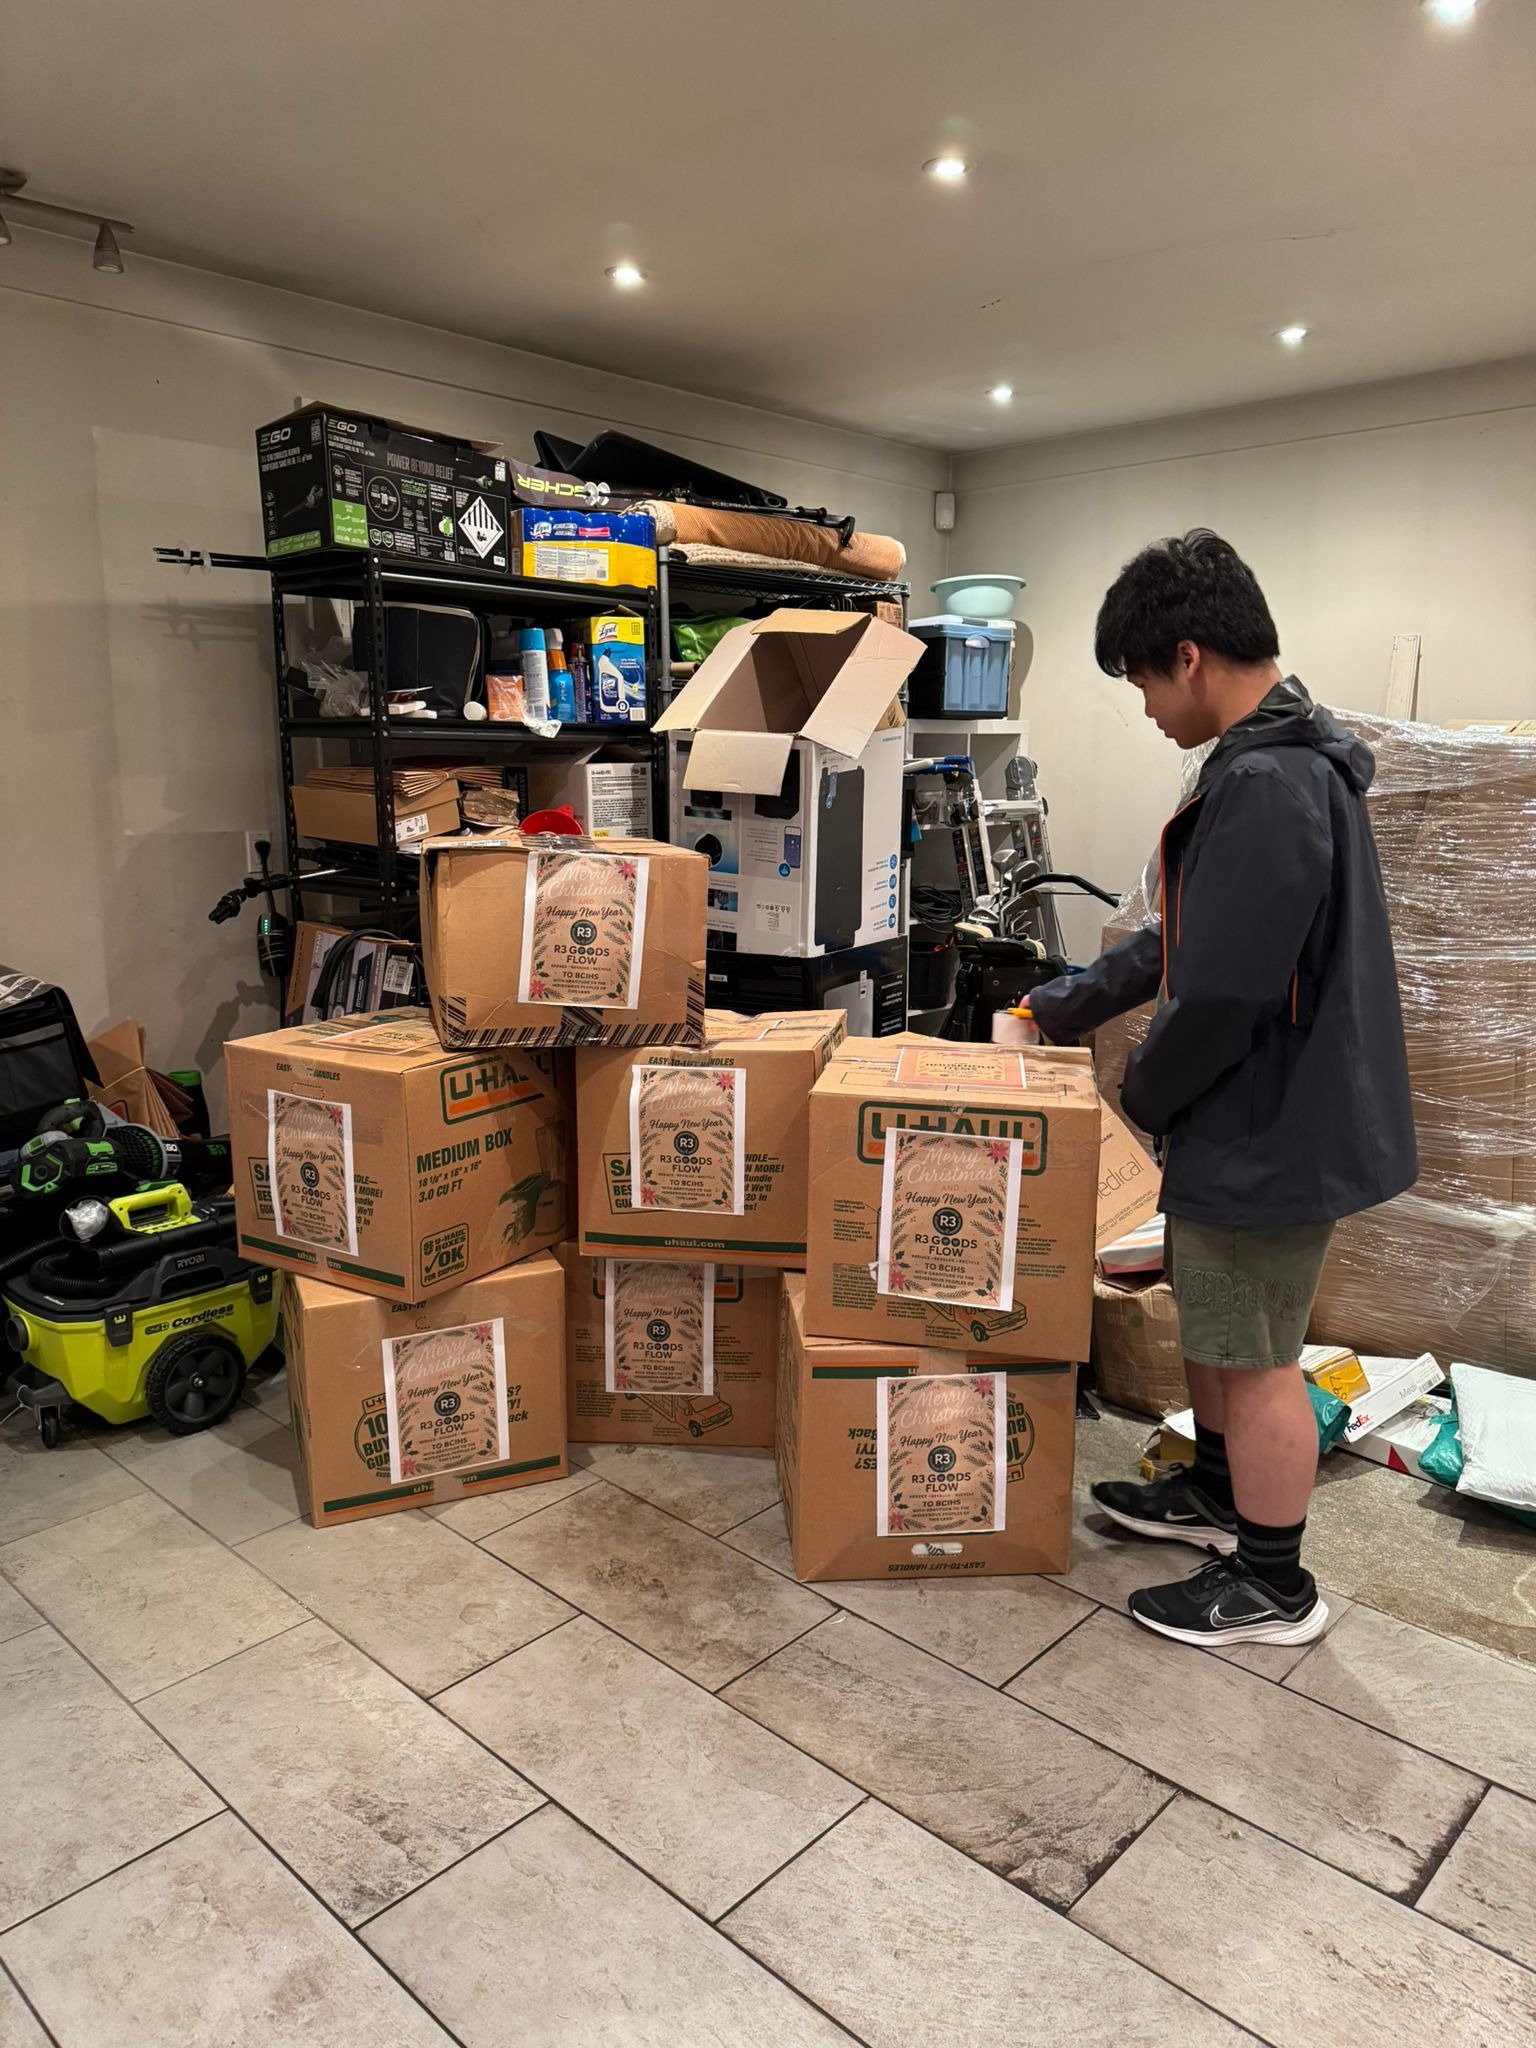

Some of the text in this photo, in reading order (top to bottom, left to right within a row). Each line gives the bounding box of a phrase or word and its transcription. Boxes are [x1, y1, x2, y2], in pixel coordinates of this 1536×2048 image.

[328, 418, 357, 433] EGO
[260, 427, 291, 446] EGO
[386, 452, 455, 480] POWER BEYOND BELIEF
[516, 473, 587, 498] SCHER
[533, 522, 552, 536] Lysol
[600, 624, 617, 636] Lysol
[519, 773, 527, 817] EARVIEW
[563, 866, 615, 886] Merry
[547, 880, 626, 900] Christmas
[546, 906, 624, 920] Happy New Year
[577, 926, 592, 938] R3
[554, 944, 610, 957] R3 GOODS
[566, 954, 598, 965] FLOW
[313, 1070, 340, 1081] HANDLES
[662, 1080, 712, 1096] Merry
[650, 1096, 725, 1113] Christmas
[290, 1109, 326, 1125] Merry
[650, 1118, 723, 1132] Happy New Year
[281, 1126, 335, 1140] Christmas
[166, 1143, 178, 1152] GO
[680, 1138, 694, 1148] R3
[282, 1146, 337, 1164] Happy New Year
[416, 1128, 513, 1174] MEDIUM BOX
[921, 1147, 982, 1167] Merry
[660, 1154, 712, 1166] R3 GOODS
[304, 1169, 316, 1180] R3
[672, 1164, 702, 1174] FLOW
[754, 1164, 785, 1173] MORE!
[906, 1163, 996, 1184] Christmas
[418, 1178, 428, 1188] 18
[752, 1184, 772, 1192] We'll
[940, 1184, 960, 1192] AND
[257, 1190, 272, 1202] BES
[290, 1184, 331, 1201] R3 GOODS
[418, 1178, 464, 1203] 3.0 CU FT
[613, 1186, 632, 1196] BES
[300, 1195, 323, 1208] FLOW
[904, 1191, 994, 1210] Happy New Year
[300, 1210, 308, 1218] TO
[938, 1215, 956, 1228] R3
[434, 1229, 466, 1245] U-HAUL
[435, 1236, 466, 1252] BOXES
[664, 1238, 726, 1249] uhaul.com
[914, 1234, 978, 1249] R3 GOODS
[438, 1248, 464, 1268] OK
[928, 1246, 964, 1257] FLOW
[177, 1253, 206, 1269] RYOBI
[924, 1262, 936, 1270] TO
[424, 1260, 465, 1282] FOR SHIPPING
[626, 1284, 697, 1300] Christmas
[172, 1303, 234, 1329] Cordless
[624, 1307, 694, 1320] Happy New Year
[652, 1326, 666, 1336] R3
[419, 1339, 470, 1364] Merry
[633, 1342, 684, 1352] R3 GOODS
[645, 1350, 672, 1359] FLOW
[406, 1349, 482, 1382] Christmas
[407, 1372, 485, 1400] Happy New Year
[440, 1398, 456, 1409] R3
[914, 1390, 970, 1410] Merry
[420, 1411, 476, 1430] R3 GOODS
[508, 1410, 528, 1423] ack
[900, 1405, 984, 1429] Christmas
[1346, 1414, 1370, 1433] FedEx
[434, 1422, 464, 1436] FLOW
[933, 1423, 952, 1432] AND
[900, 1428, 984, 1448] Happy New Year
[432, 1442, 443, 1450] TO
[934, 1453, 950, 1465] R3
[912, 1472, 972, 1484] R3 GOODS
[926, 1482, 958, 1492] FLOW
[922, 1500, 934, 1508] TO
[888, 1561, 986, 1572] EASY-TO-LIFT HANDLES
